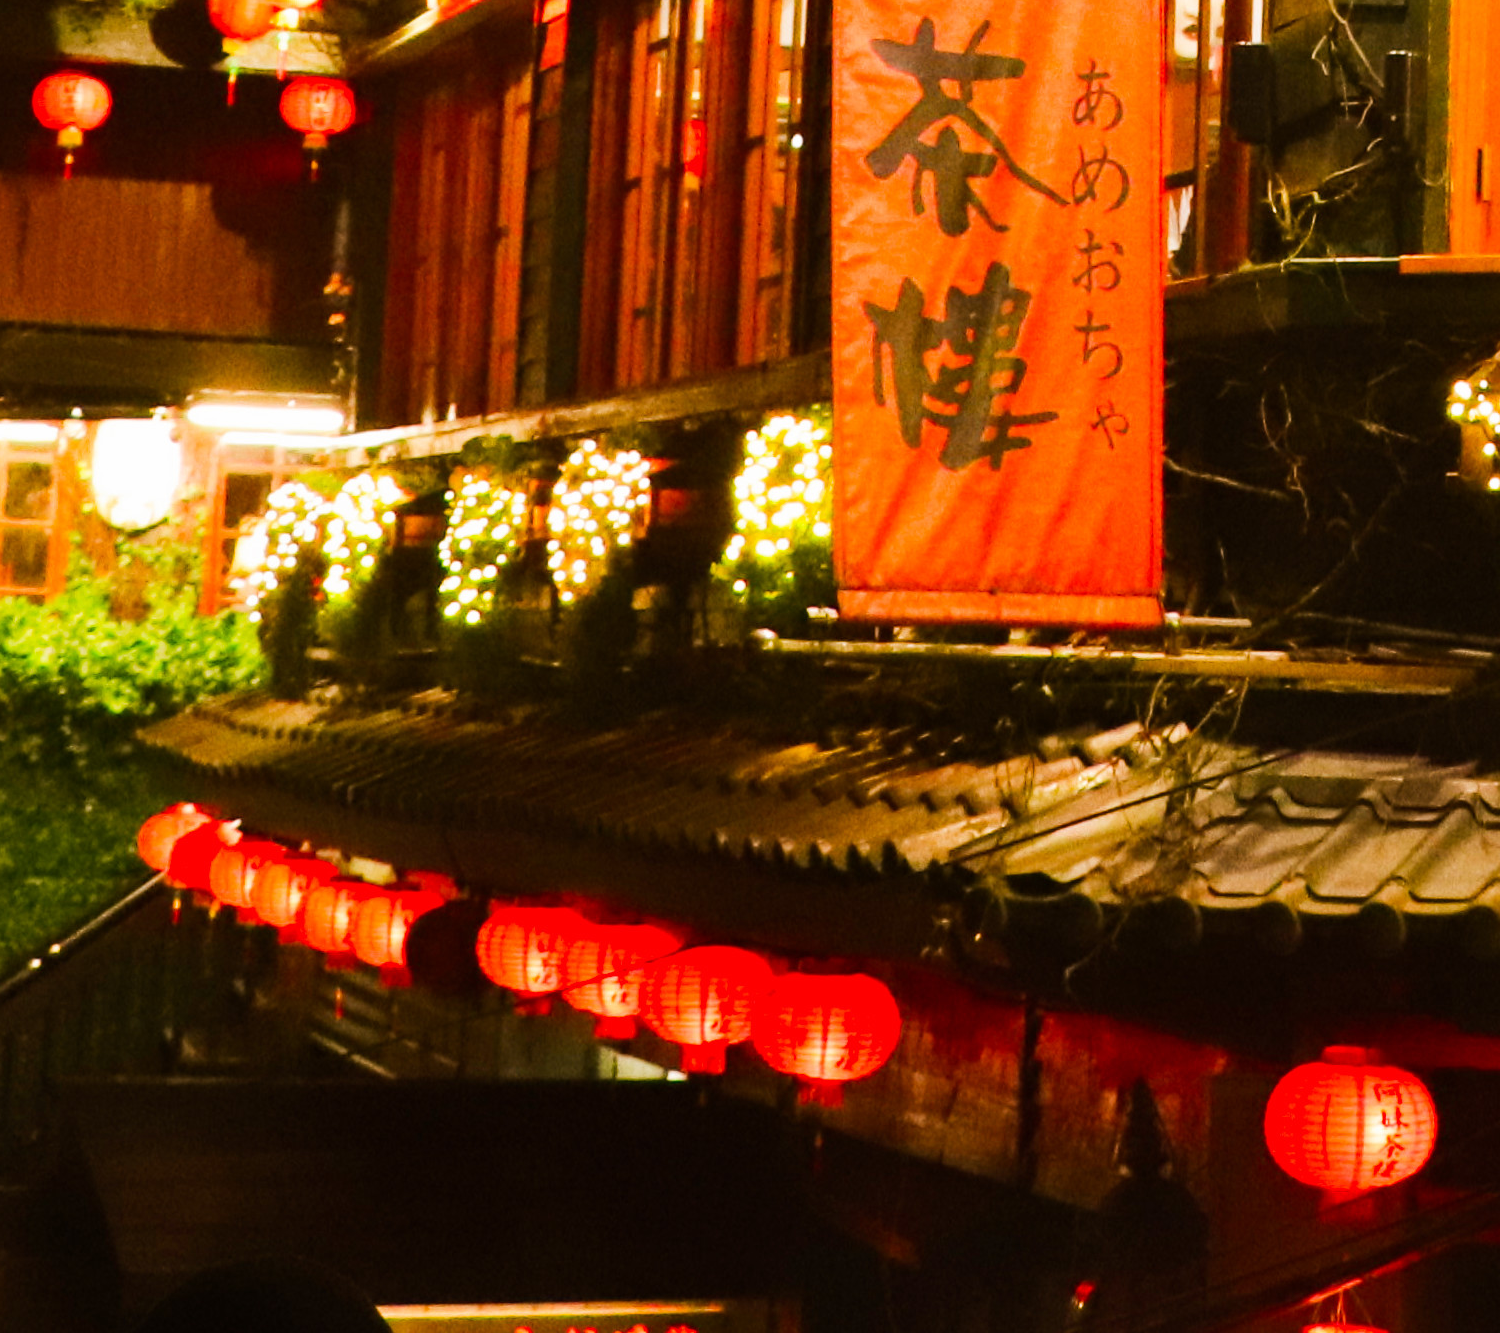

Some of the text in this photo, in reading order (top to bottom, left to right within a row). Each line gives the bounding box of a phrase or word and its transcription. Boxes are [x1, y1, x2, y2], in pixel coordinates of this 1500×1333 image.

[1070, 58, 1132, 451] あめおちゃ
